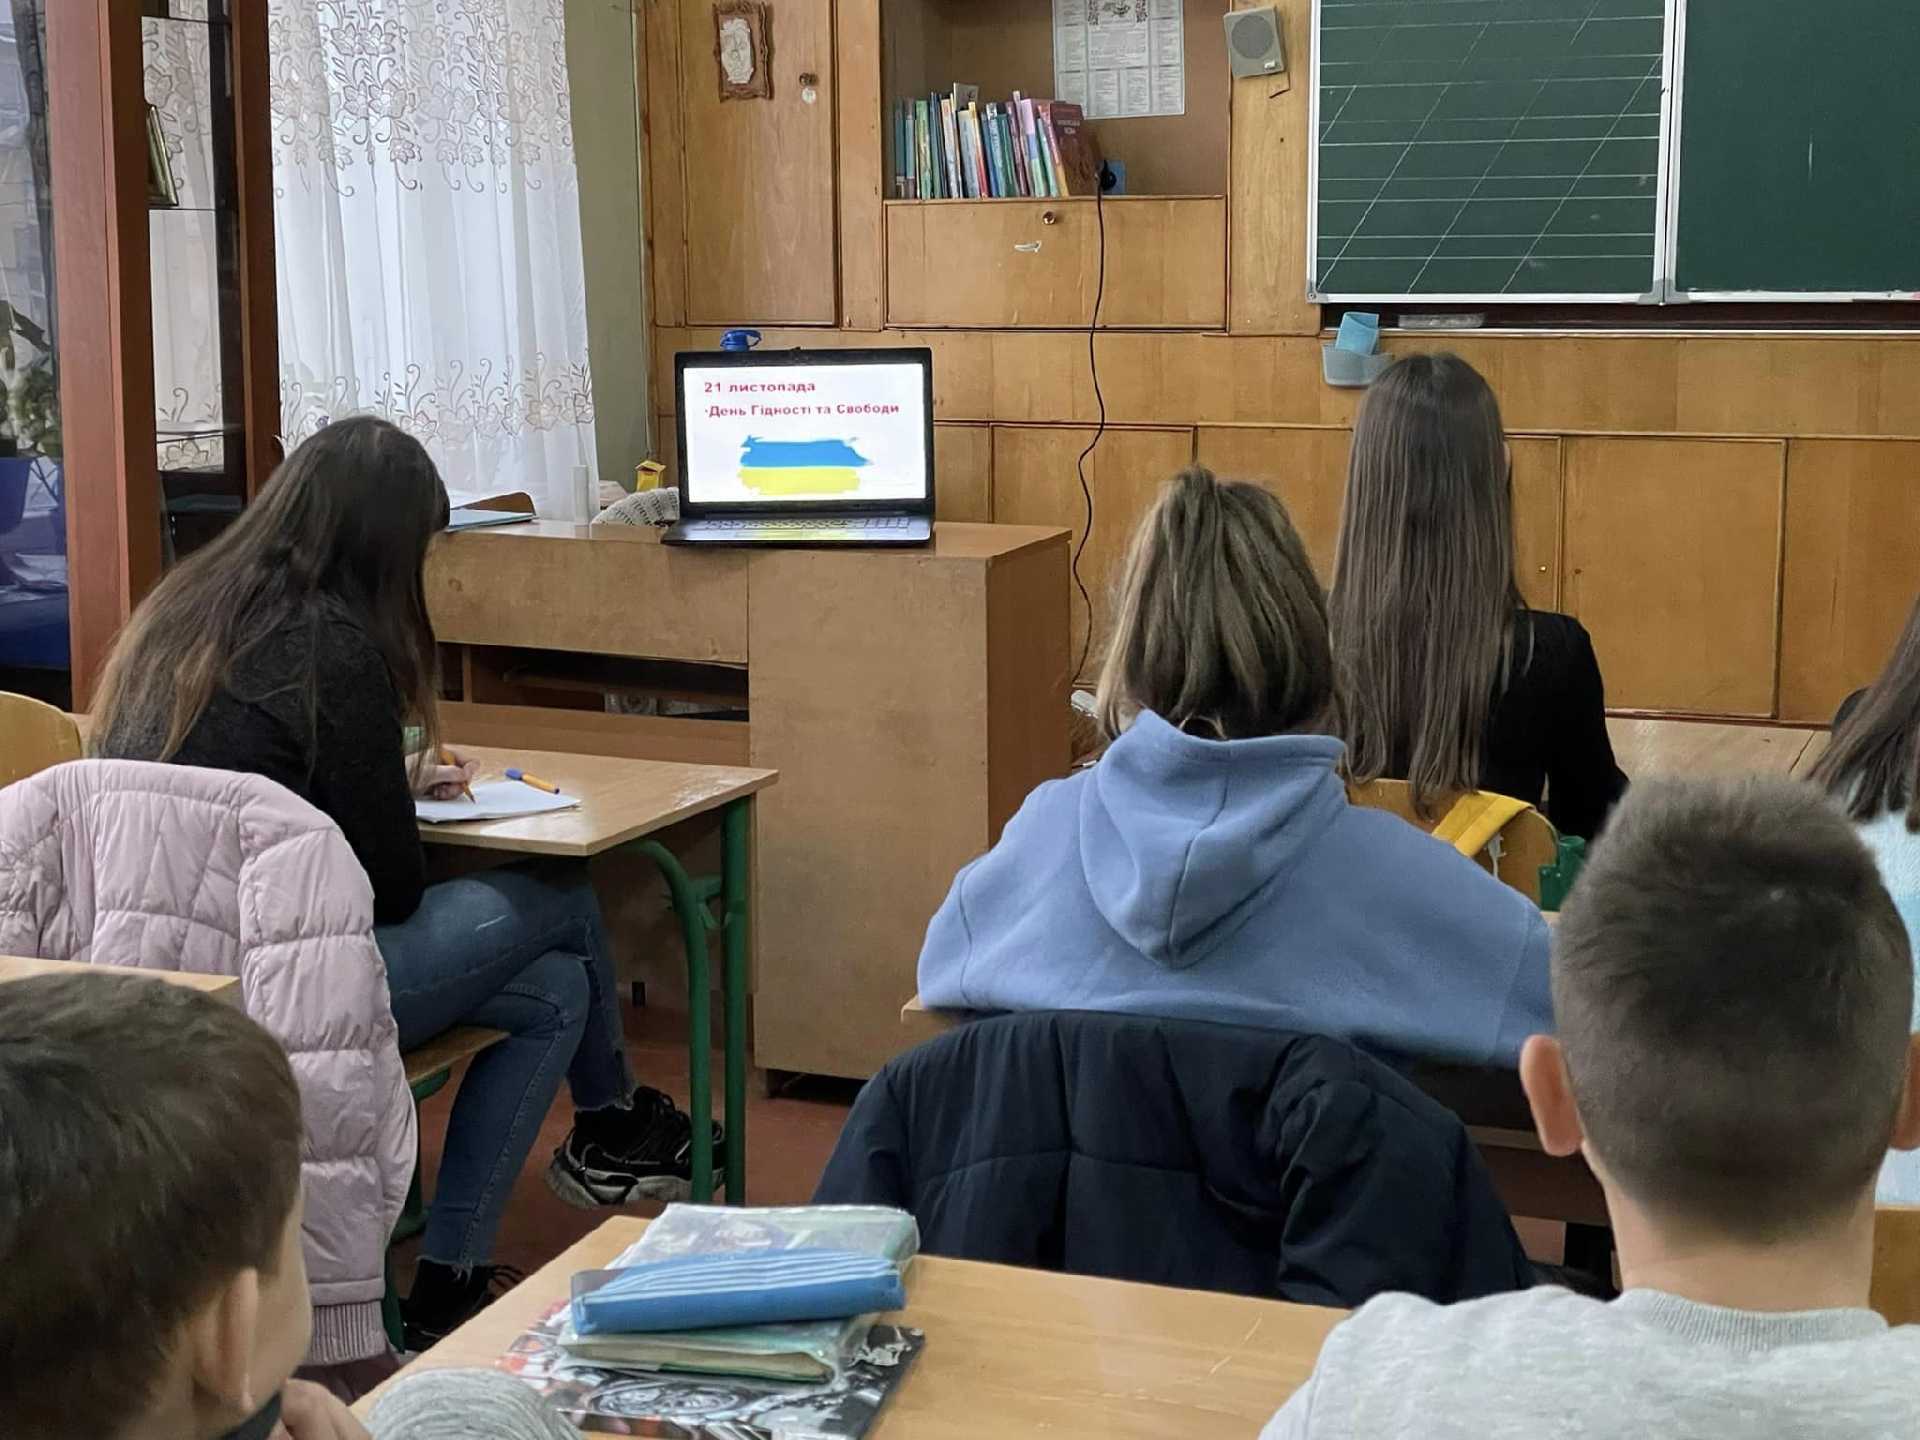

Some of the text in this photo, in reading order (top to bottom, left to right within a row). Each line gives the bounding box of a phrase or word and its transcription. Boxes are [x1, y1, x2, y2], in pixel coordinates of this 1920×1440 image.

[704, 382, 816, 393] 21 листопада
[751, 404, 811, 416] Гідності
[817, 405, 831, 415] та
[836, 403, 900, 415] Свободи
